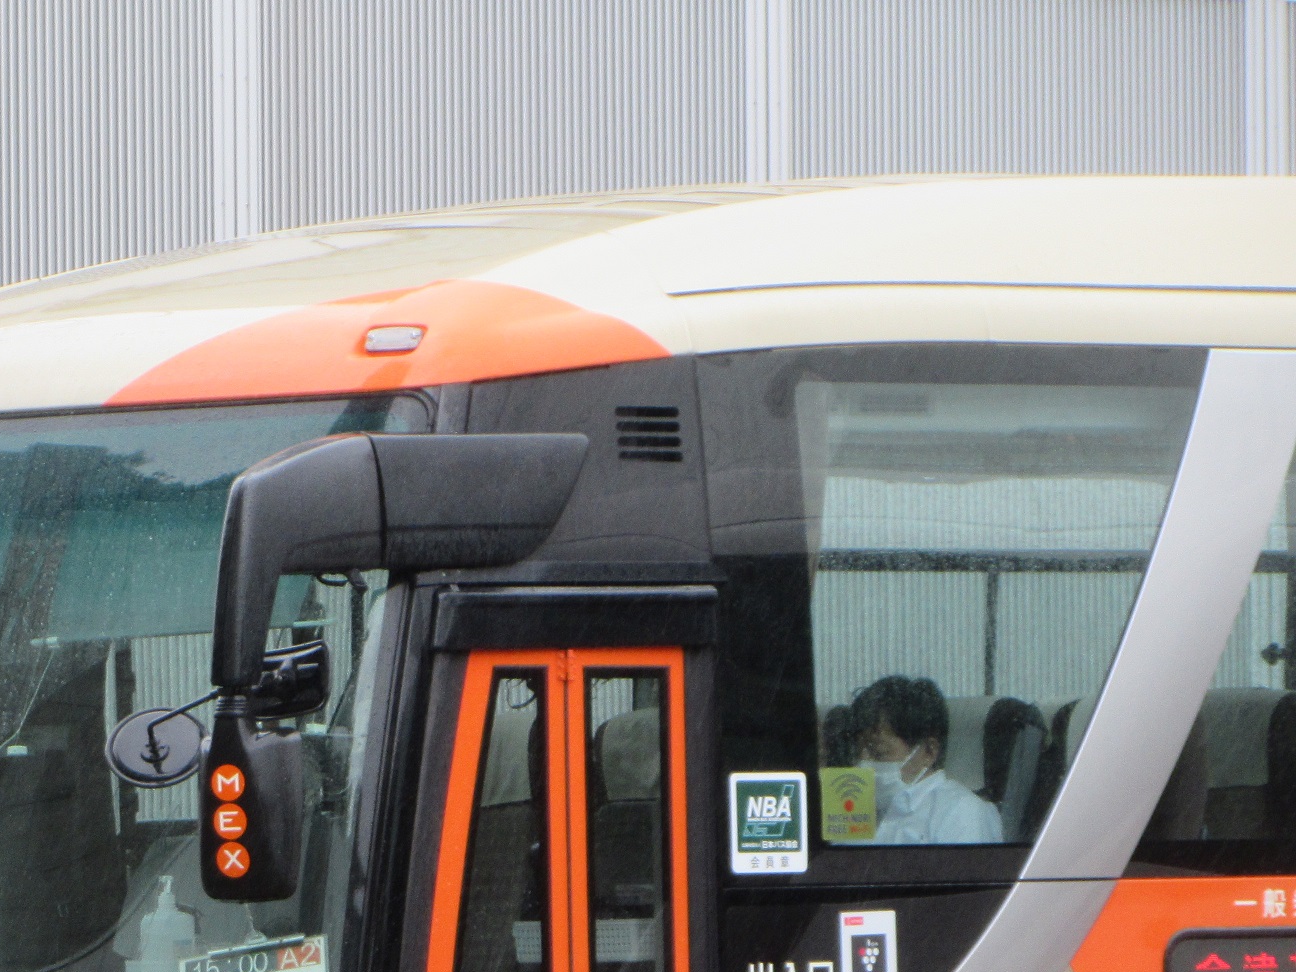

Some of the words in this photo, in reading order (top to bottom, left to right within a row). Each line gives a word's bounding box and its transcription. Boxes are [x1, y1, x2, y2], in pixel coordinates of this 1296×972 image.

[747, 795, 792, 818] NBA
[215, 771, 245, 871] MEX
[1233, 888, 1296, 918] 一般
[279, 942, 320, 969] A2
